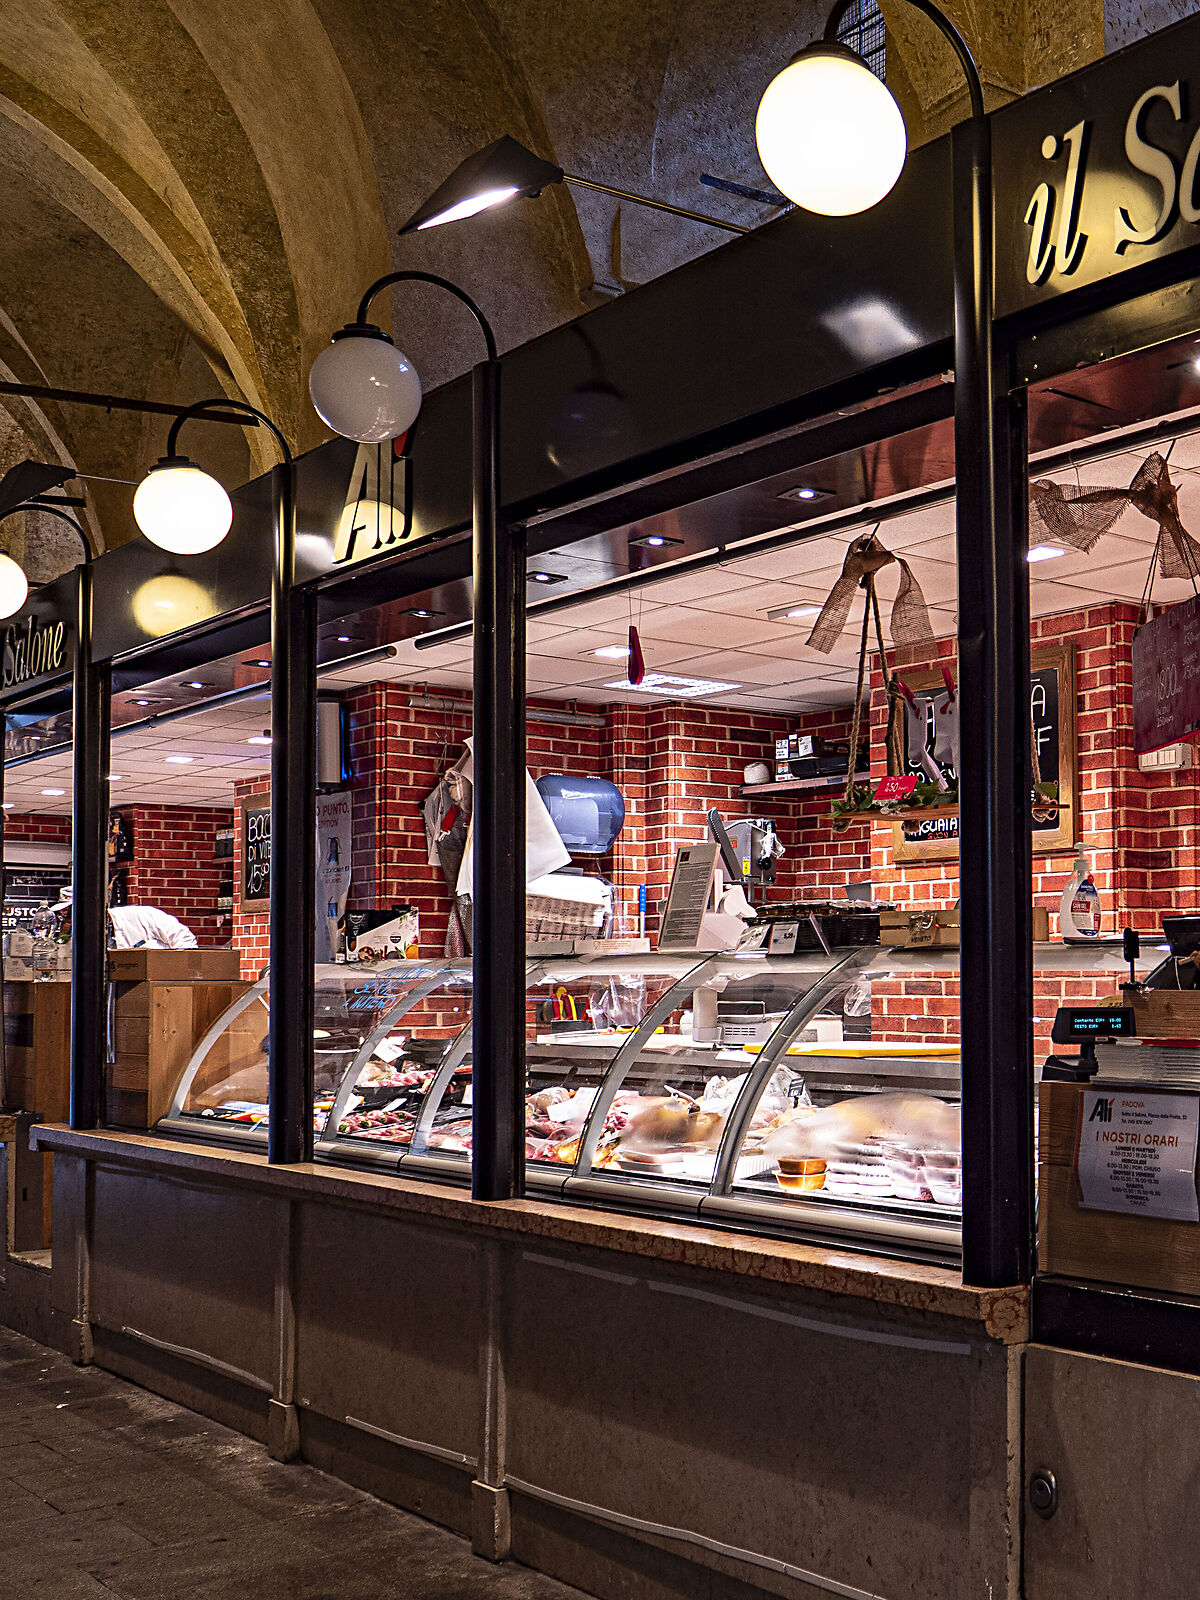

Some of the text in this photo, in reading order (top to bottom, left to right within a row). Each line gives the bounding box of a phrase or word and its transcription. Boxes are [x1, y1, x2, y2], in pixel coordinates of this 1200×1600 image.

[1024, 119, 1089, 285] il
[4, 614, 64, 686] Salone
[1121, 1100, 1145, 1109] PADOVA
[1096, 1131, 1179, 1147] I NOSTRI ORARI
